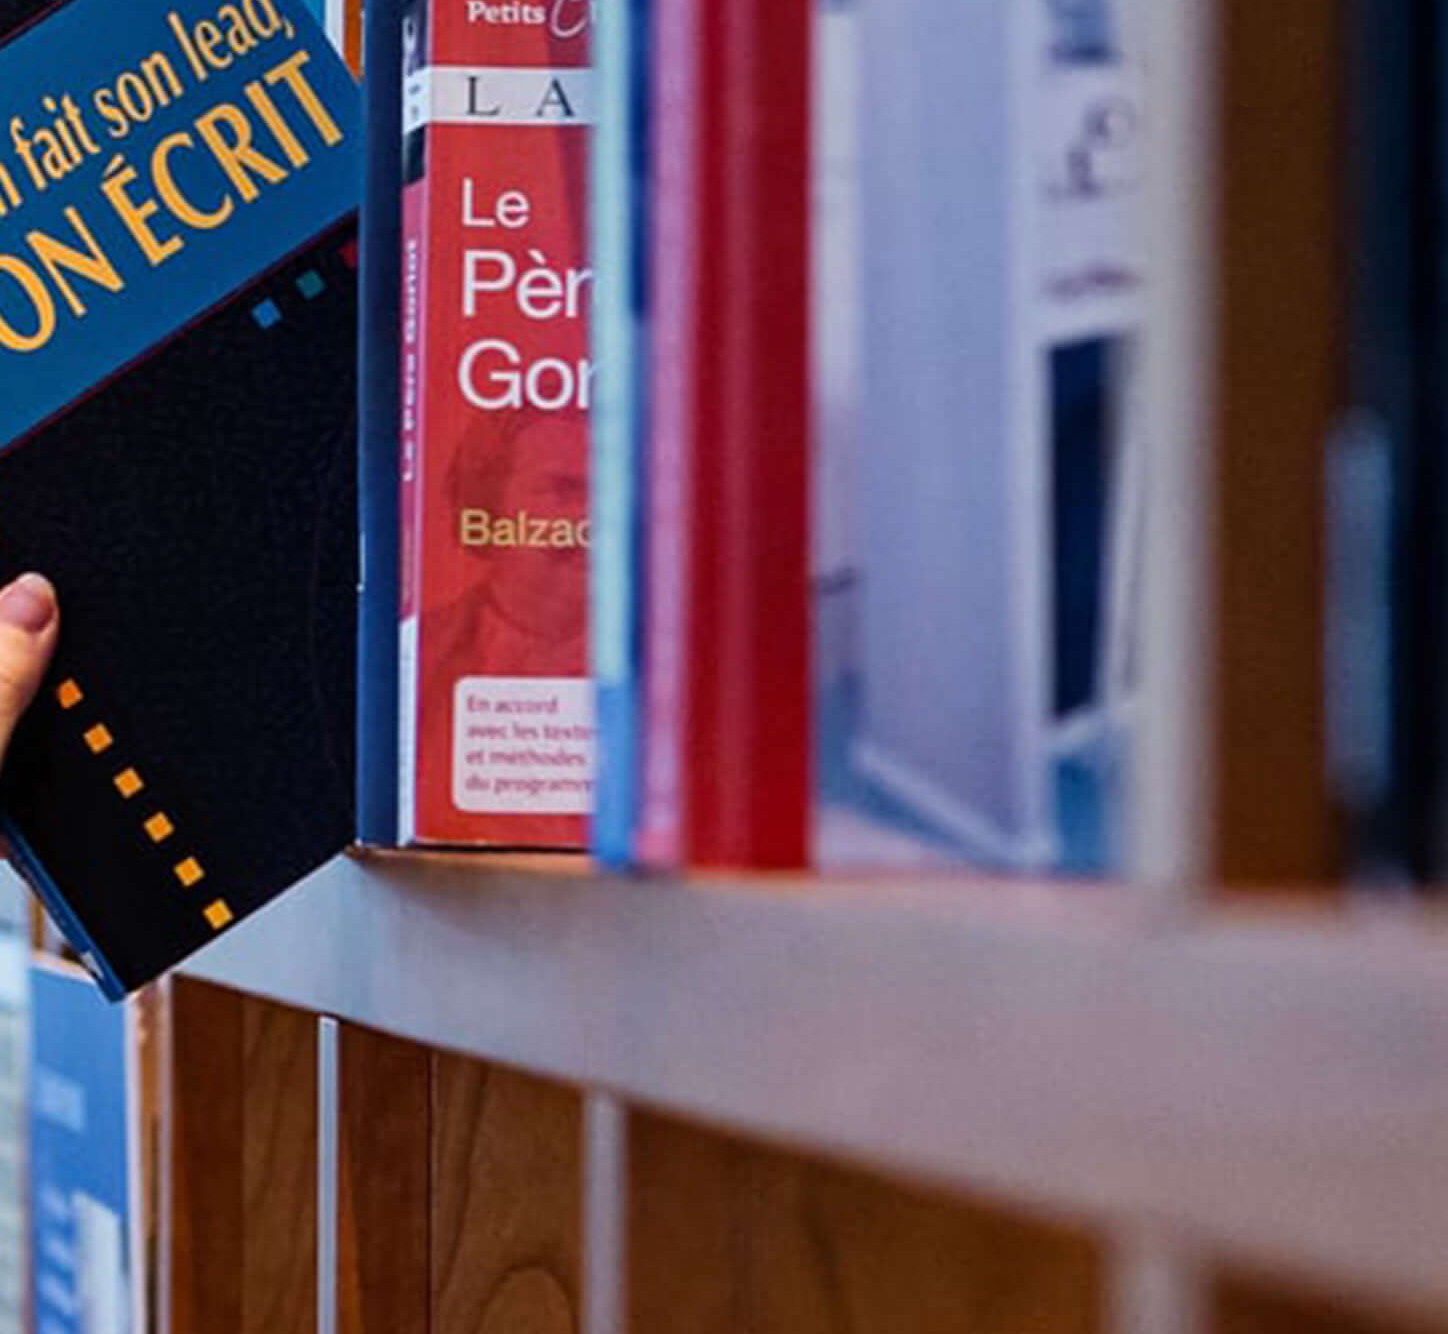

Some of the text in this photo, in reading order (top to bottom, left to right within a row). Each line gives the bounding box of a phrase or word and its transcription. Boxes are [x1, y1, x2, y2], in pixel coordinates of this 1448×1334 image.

[8, 90, 101, 193] fait
[96, 51, 184, 137] son
[103, 50, 343, 268] ÉCRIT
[461, 177, 530, 229] Le
[460, 508, 594, 548] Balzac
[466, 694, 559, 714] En accord
[467, 722, 596, 740] avec les texte
[465, 749, 485, 766] et
[465, 772, 491, 791] du
